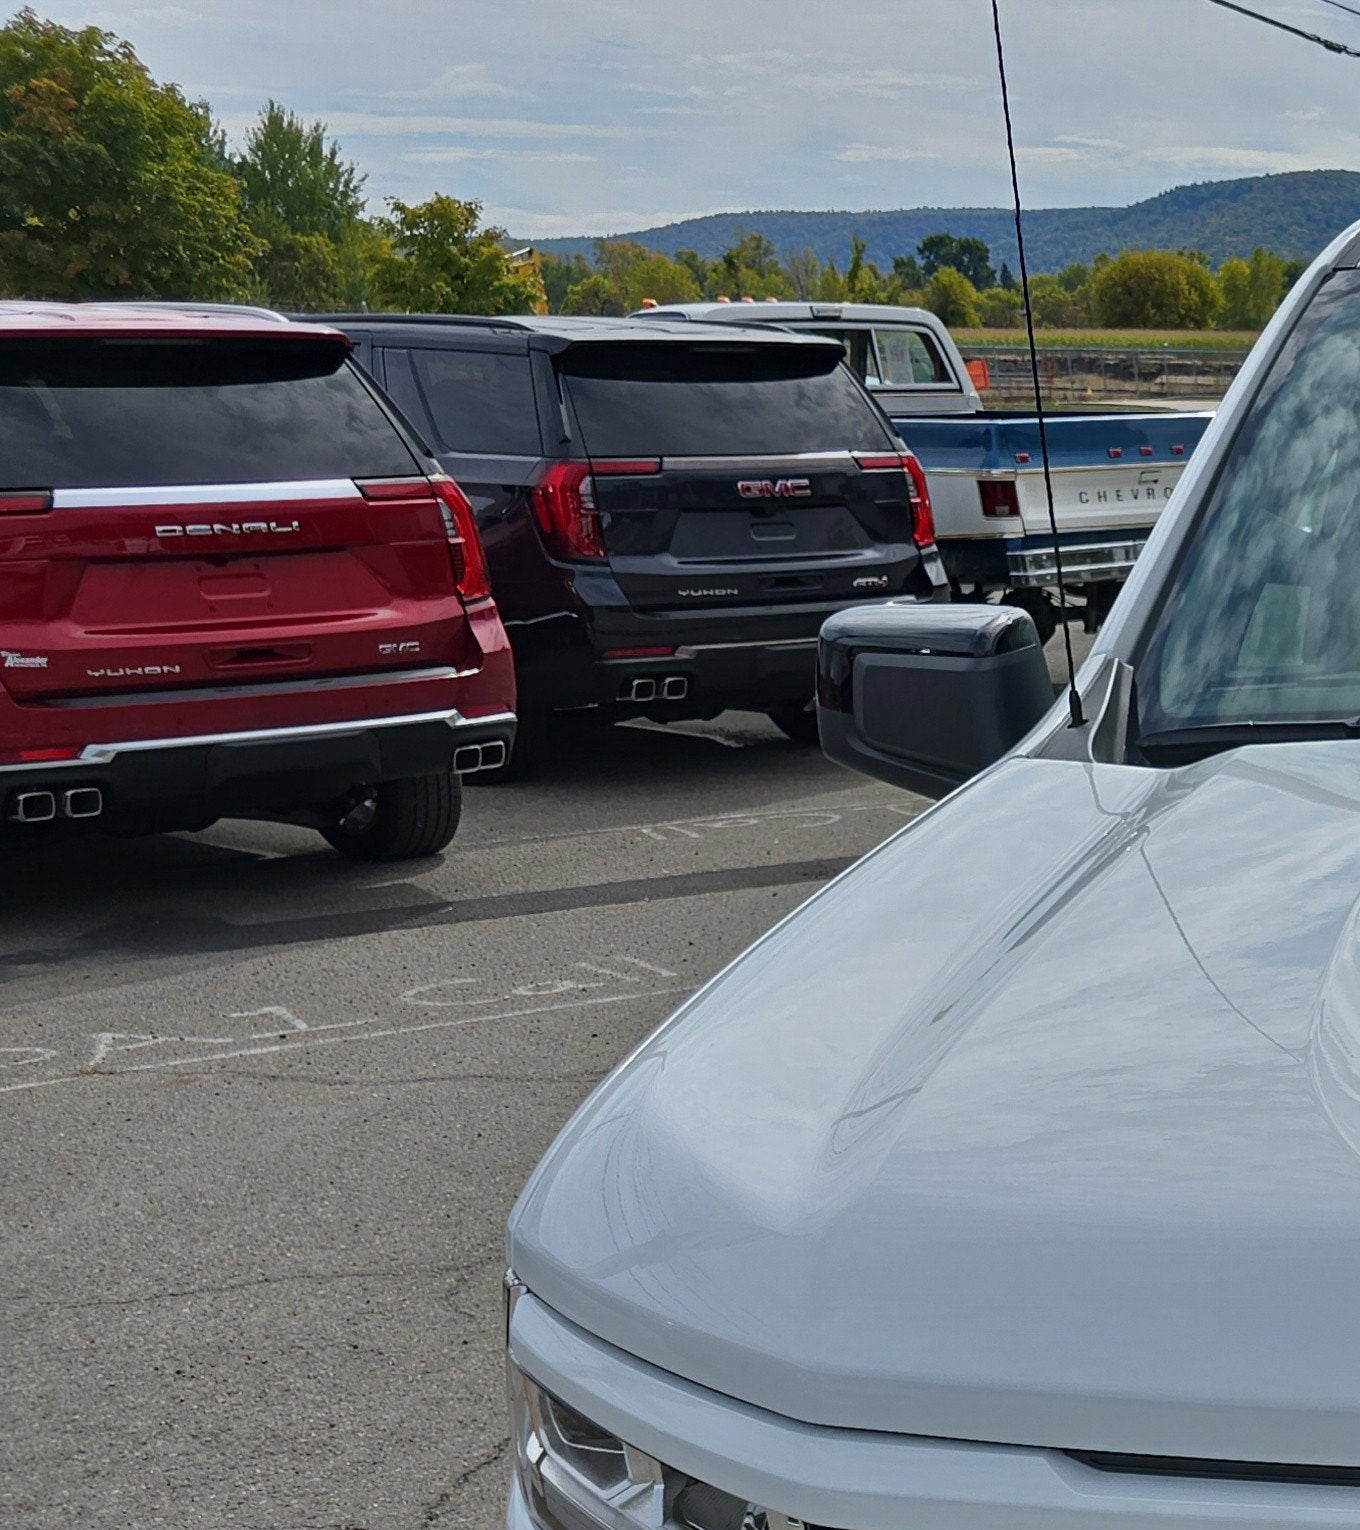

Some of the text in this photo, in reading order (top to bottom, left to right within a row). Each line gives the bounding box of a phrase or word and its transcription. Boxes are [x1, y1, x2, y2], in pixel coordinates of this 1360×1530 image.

[737, 479, 812, 498] GMC
[155, 520, 300, 538] DENALI
[677, 588, 739, 597] YUKON
[378, 641, 421, 655] GMC
[86, 665, 182, 677] YUKON
